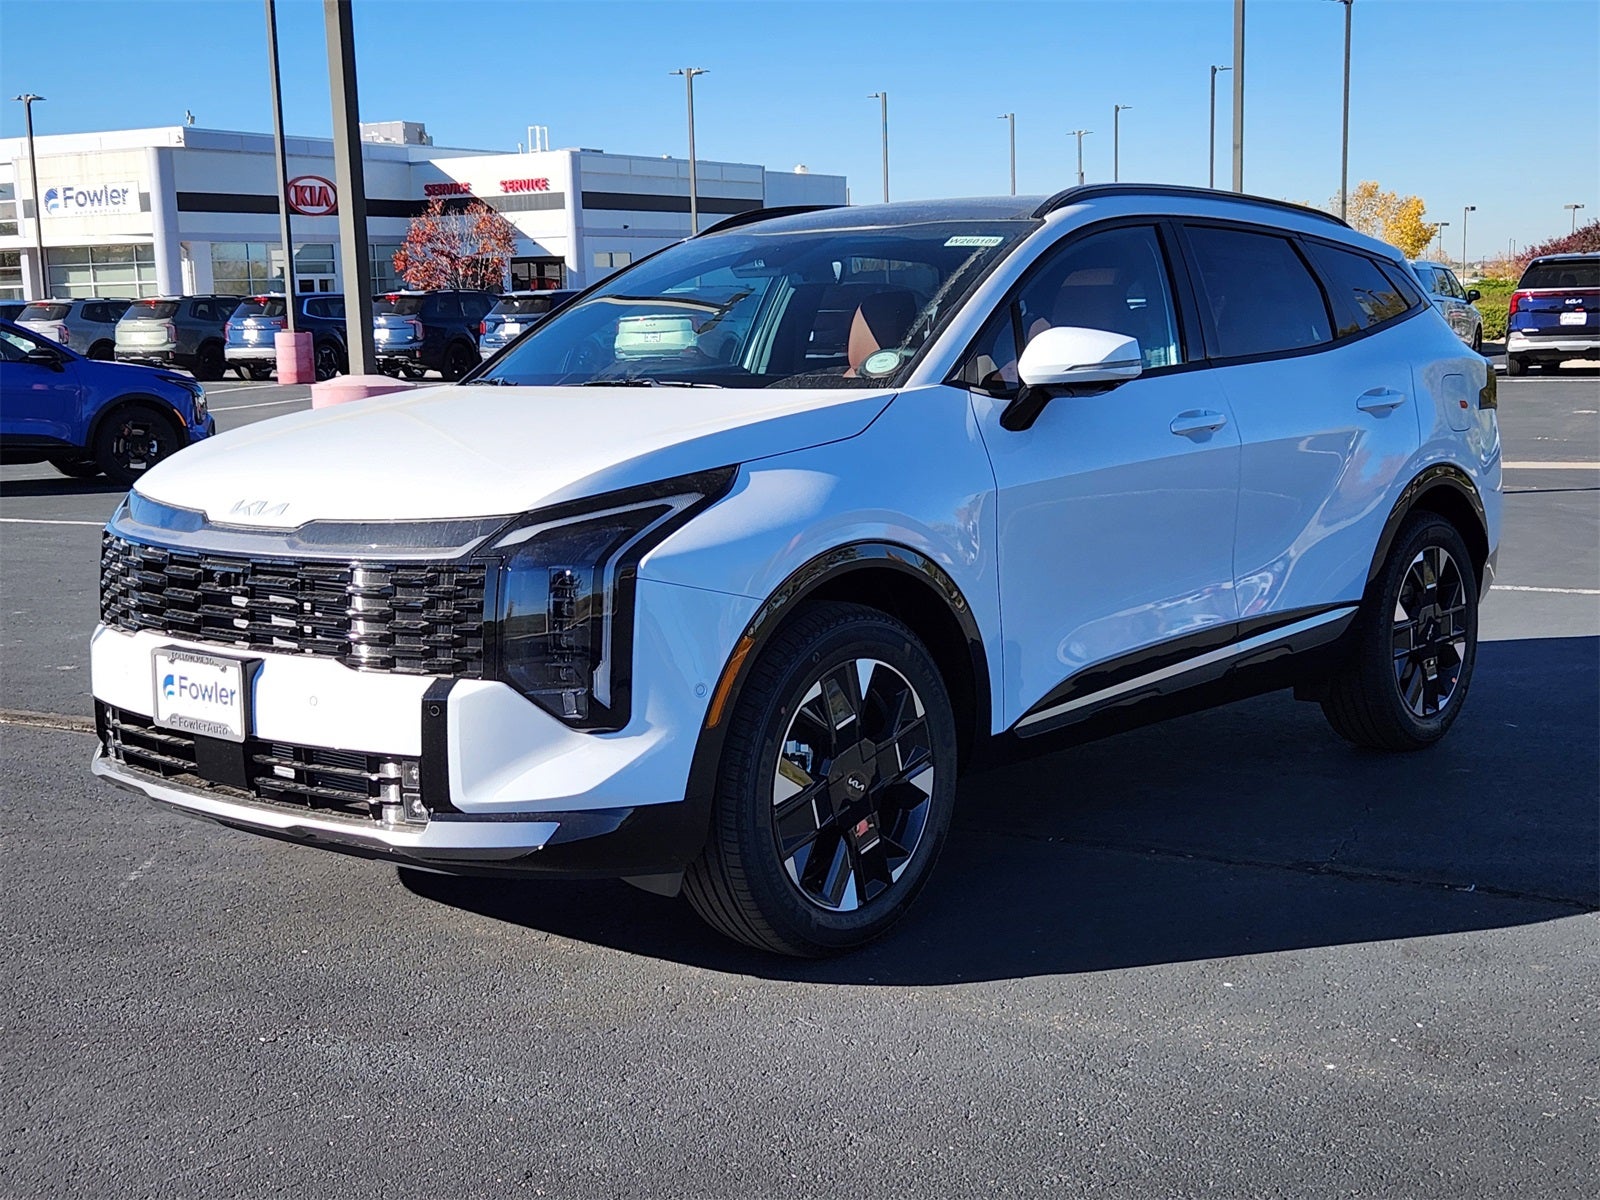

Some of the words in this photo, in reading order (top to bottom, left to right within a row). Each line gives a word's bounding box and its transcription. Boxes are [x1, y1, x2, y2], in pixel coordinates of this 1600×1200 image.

[424, 182, 471, 197] SERVICE
[500, 178, 549, 193] SERVICE
[63, 185, 128, 208] Fowler
[294, 185, 332, 207] KIA
[178, 675, 236, 706] Fowler
[178, 717, 228, 735] FowlerAuto
